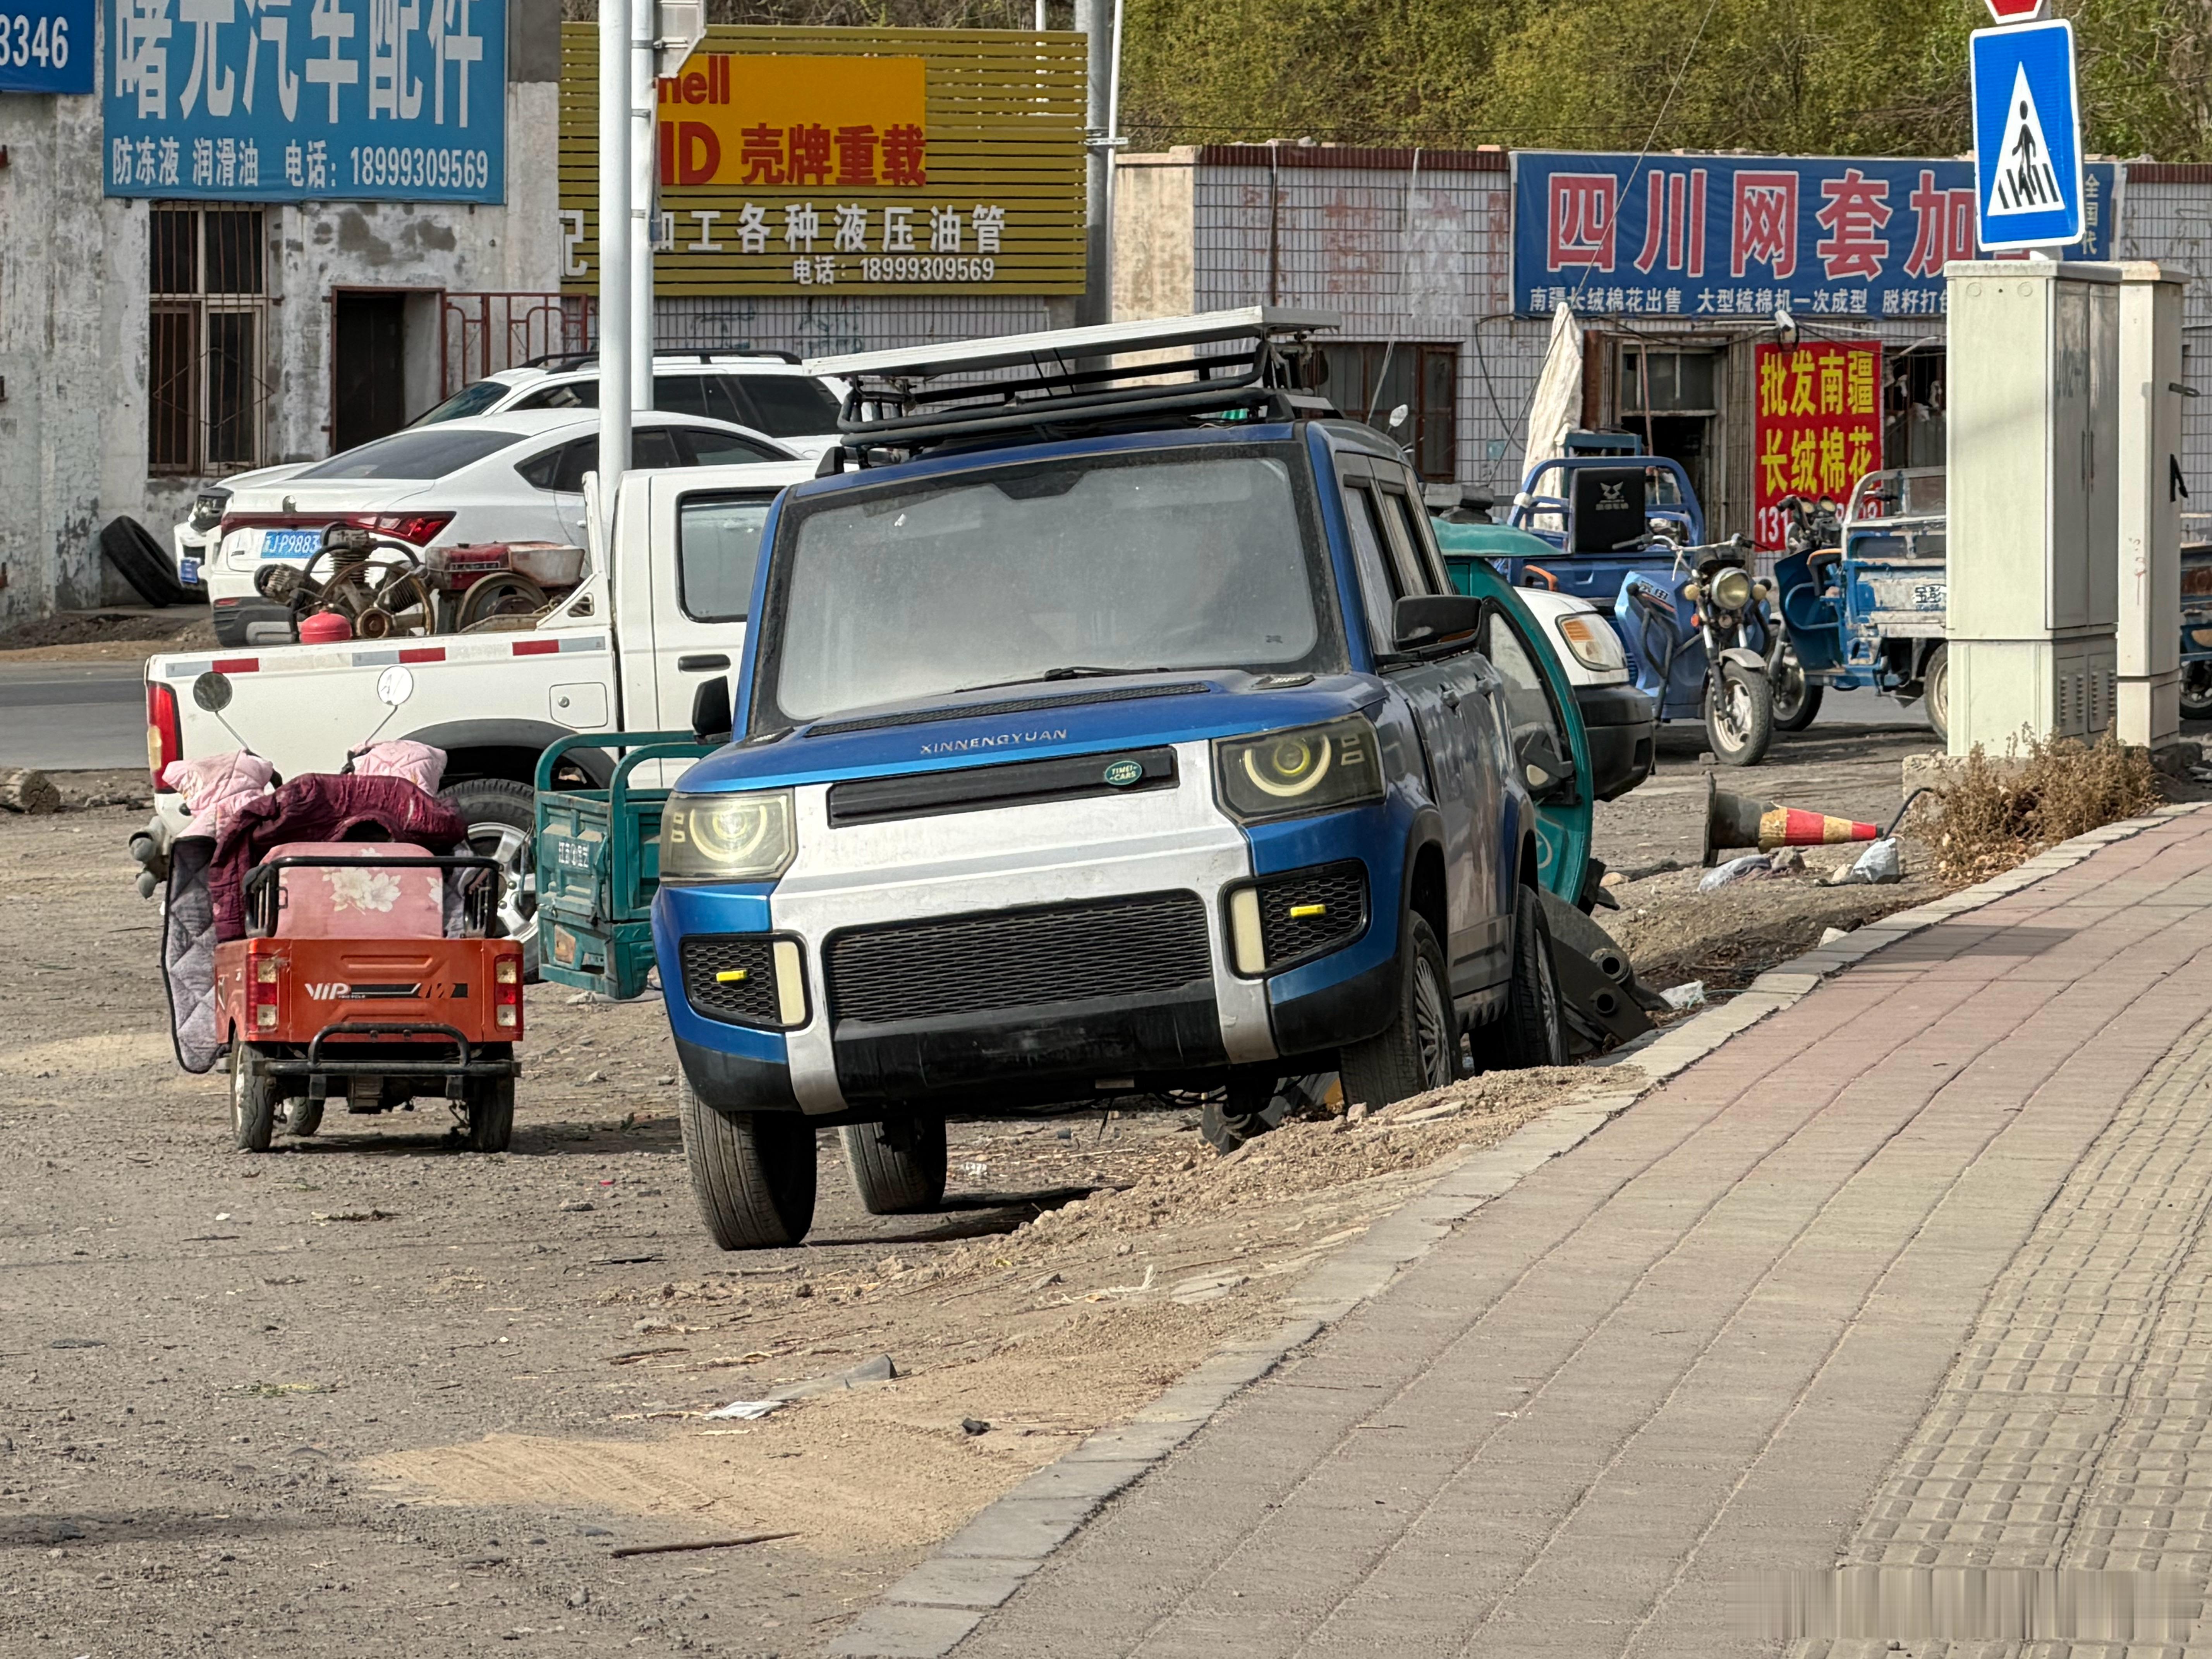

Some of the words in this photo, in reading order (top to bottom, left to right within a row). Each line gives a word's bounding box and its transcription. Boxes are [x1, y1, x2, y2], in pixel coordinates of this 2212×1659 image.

[113, 136, 180, 185] 防冻液
[192, 137, 258, 187] 润滑油
[350, 146, 488, 189] 18999309569
[740, 122, 926, 186] 壳牌重载
[1547, 168, 2030, 282] 四川网套加
[860, 257, 994, 281] 18999309569
[1530, 287, 1681, 313] 南疆长绒棉花出售
[1697, 288, 1867, 314] 大型梳棉机一次成型
[1760, 349, 1874, 417] 批发南疆
[1760, 426, 1874, 497] 长绒棉花
[921, 729, 1067, 754] XINNENGYUAN
[304, 982, 350, 1000] VIP
